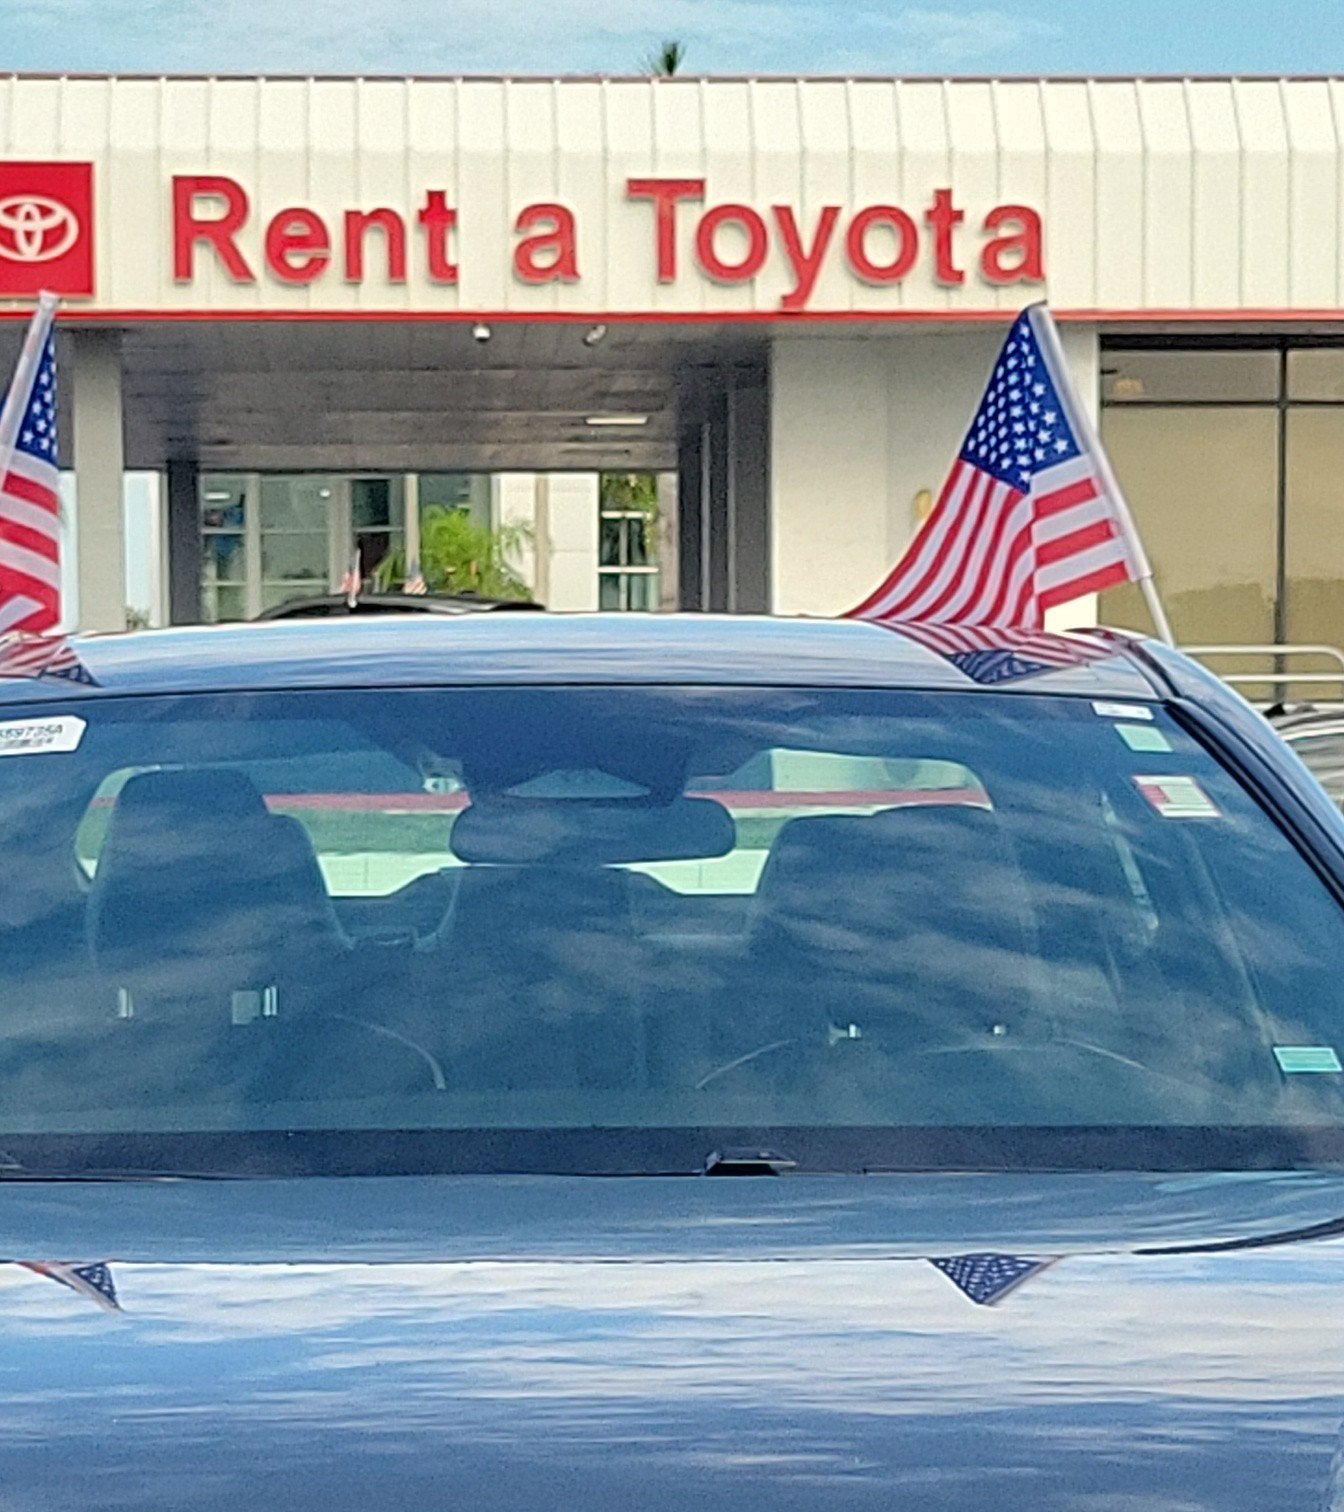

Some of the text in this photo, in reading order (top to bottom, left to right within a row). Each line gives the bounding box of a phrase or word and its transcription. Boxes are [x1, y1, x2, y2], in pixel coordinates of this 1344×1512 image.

[172, 176, 1045, 309] Rent a Toyota
